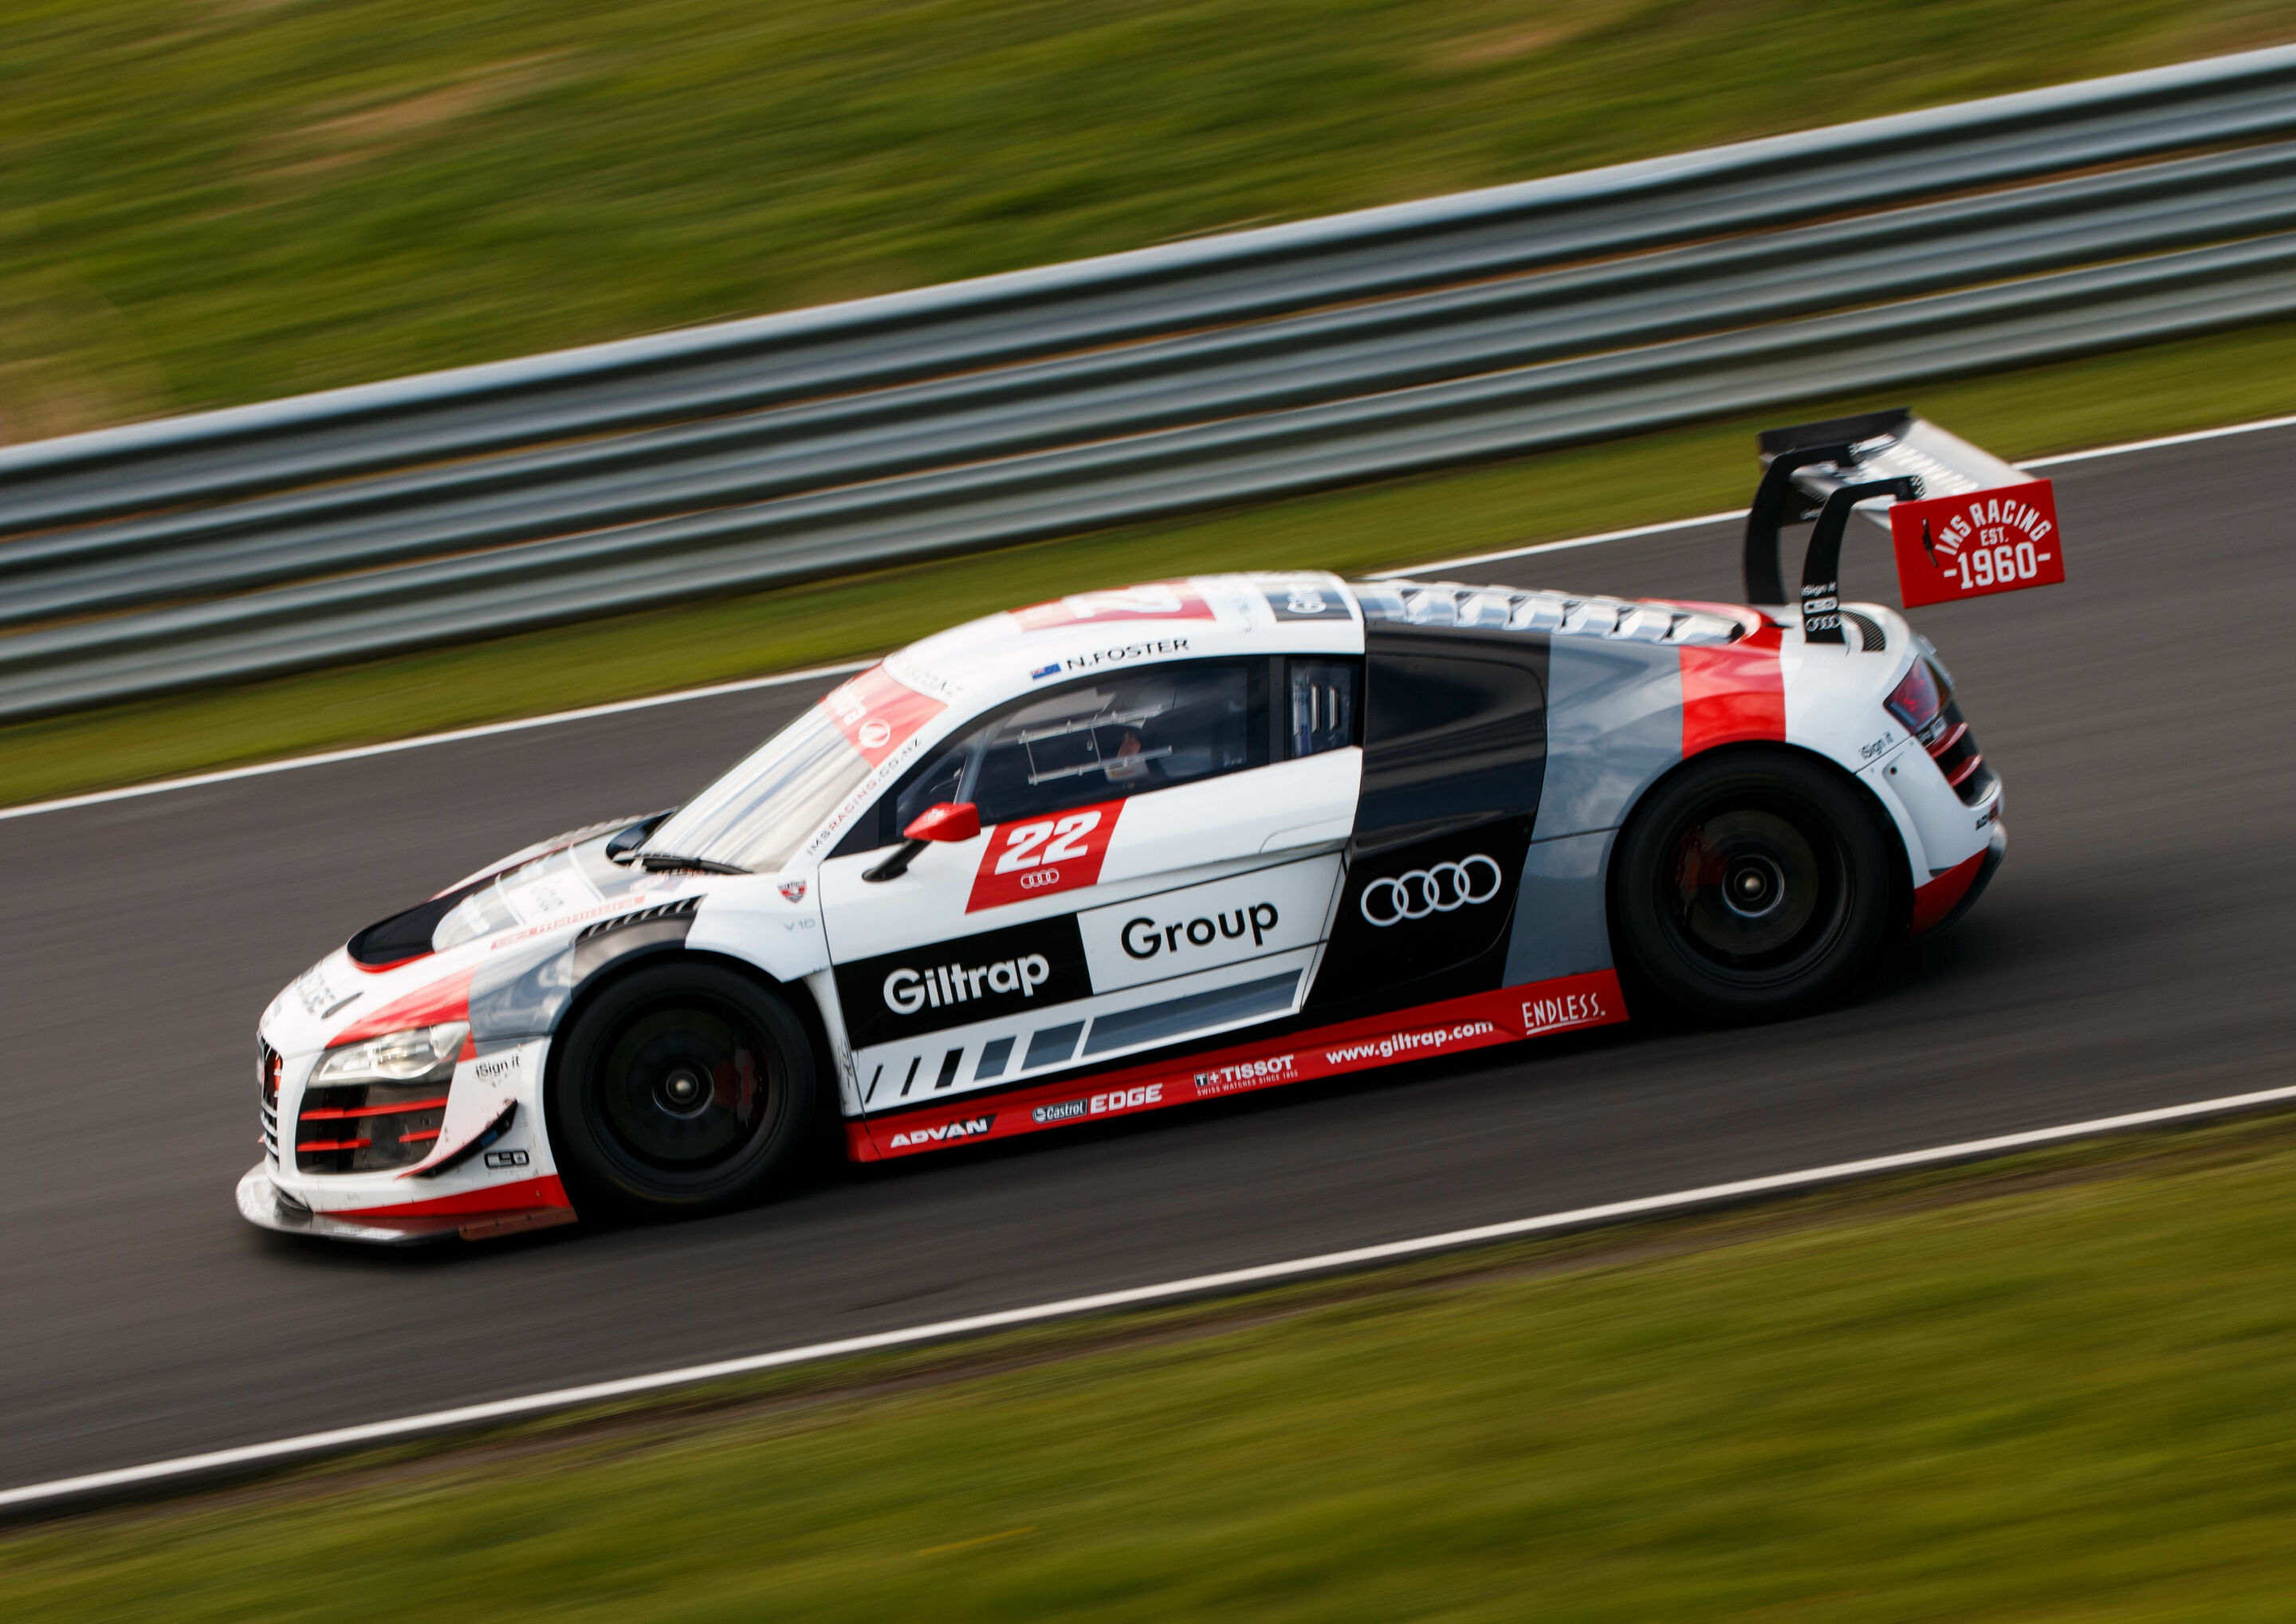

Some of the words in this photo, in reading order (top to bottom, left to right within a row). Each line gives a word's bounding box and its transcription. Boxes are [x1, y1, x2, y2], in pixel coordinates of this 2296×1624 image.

[1935, 514, 1972, 556] IMS
[1968, 498, 2053, 542] RACING
[1980, 526, 2009, 547] EST.
[1067, 638, 1190, 670] N.FOSTER
[994, 810, 1102, 875] 22
[883, 953, 1050, 1015] Giltrap
[1121, 902, 1280, 959] Group
[1326, 1020, 1494, 1066] www.giltrap.com
[1046, 1099, 1085, 1120] Castrol
[1090, 1083, 1163, 1115] EDGE
[1197, 1085, 1221, 1097] SWISS
[1222, 1079, 1256, 1092] WATCHES
[1259, 1073, 1280, 1084] SINCE
[1282, 1069, 1299, 1079] 1853
[890, 1118, 989, 1148] ADVAN
